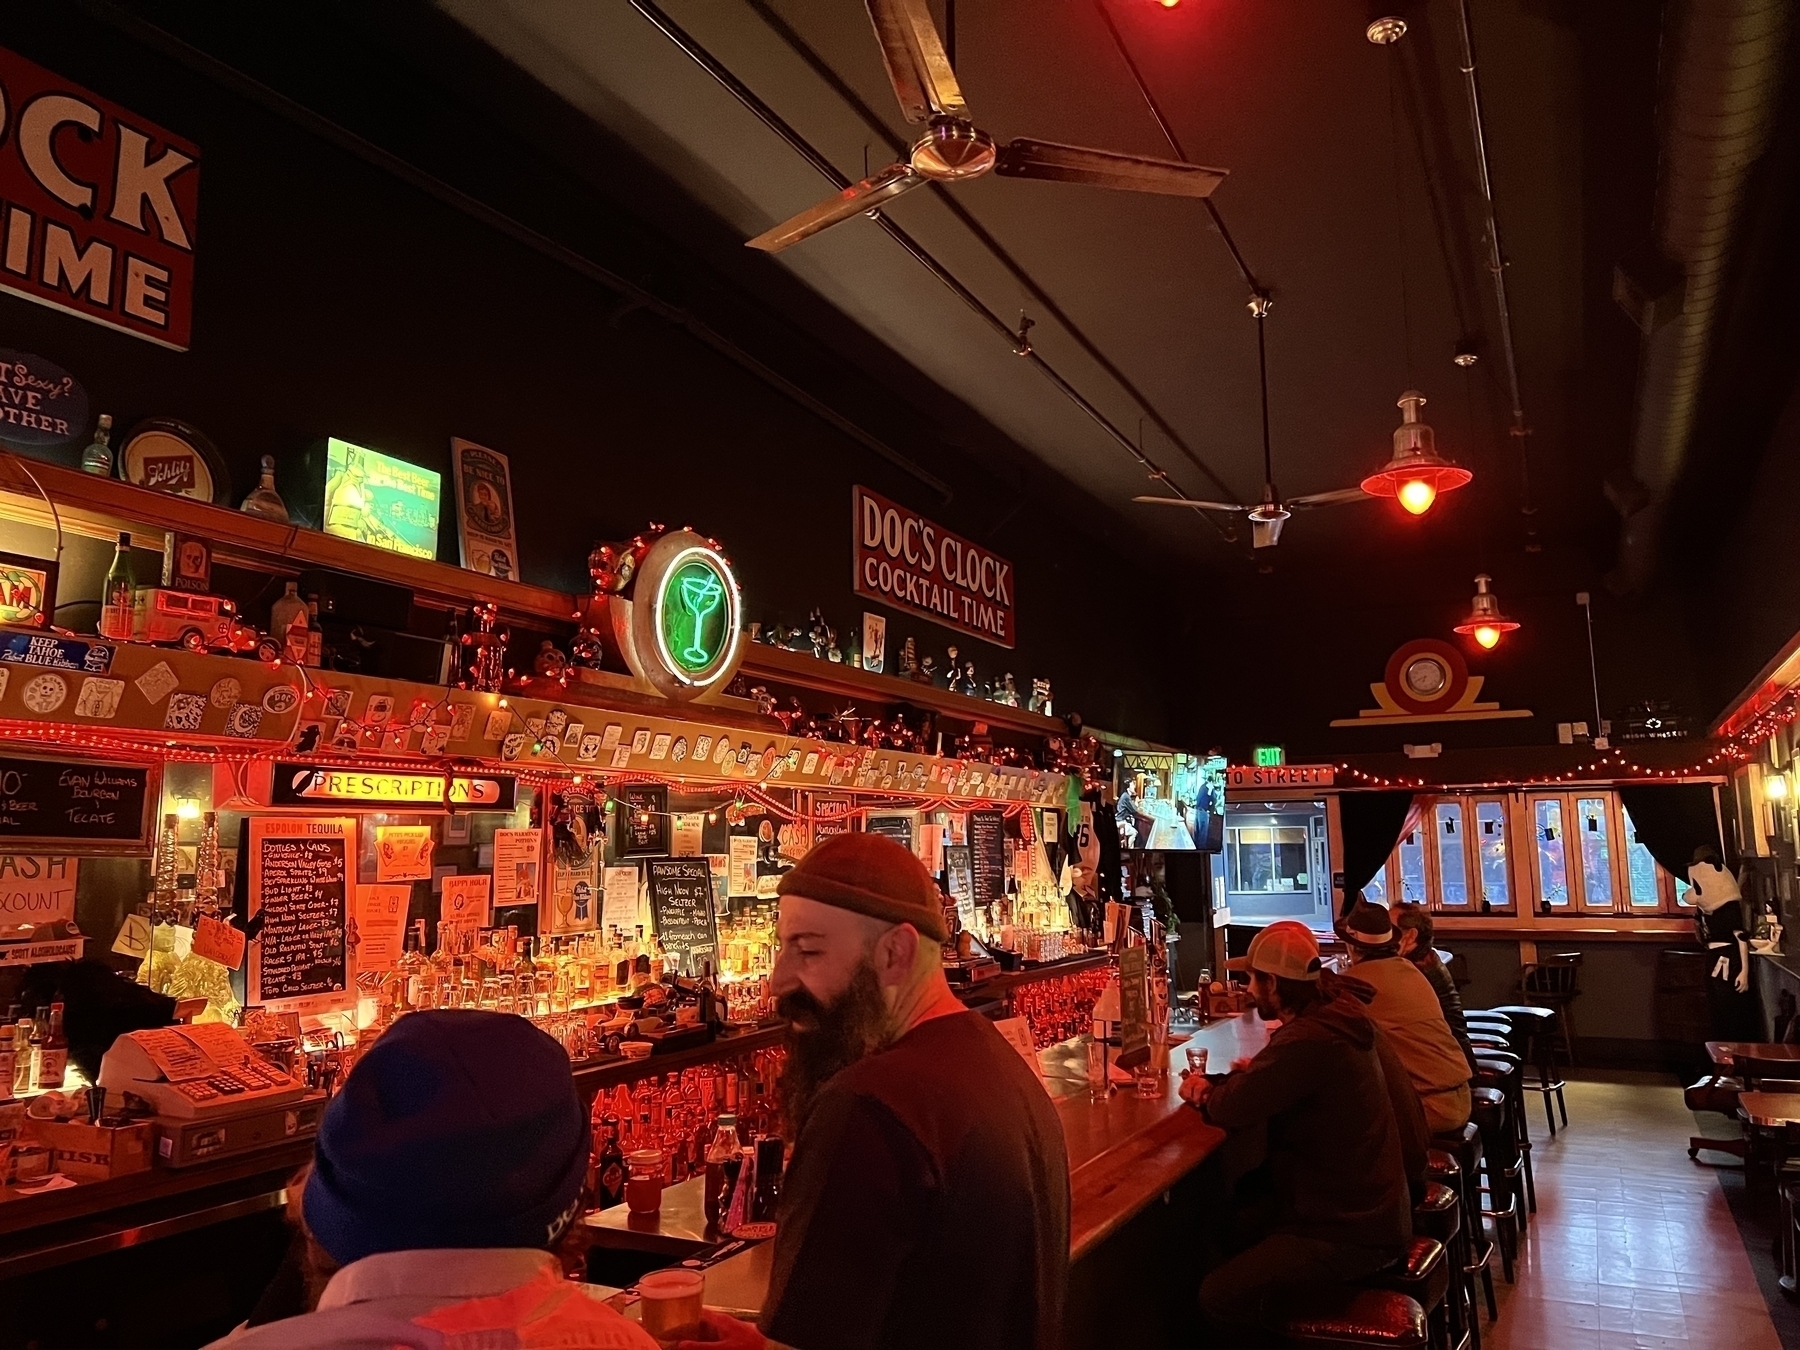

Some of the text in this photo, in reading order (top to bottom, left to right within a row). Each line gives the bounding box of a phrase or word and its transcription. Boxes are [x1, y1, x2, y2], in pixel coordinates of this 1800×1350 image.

[0, 82, 194, 250] CK
[13, 360, 73, 399] Sexy?
[376, 461, 430, 487] The Best Beer
[475, 466, 495, 482] NICE
[416, 485, 435, 501] Time
[375, 533, 393, 550] San
[393, 539, 433, 559] Francisco
[863, 495, 1010, 607] DOC'S CLOCK
[175, 577, 209, 592] POISON
[864, 557, 1006, 637] COCKTAIL TIME
[30, 636, 58, 648] KEEP
[25, 653, 52, 666] BLUE
[29, 645, 64, 658] TAHOE
[1258, 748, 1281, 766] EXIT
[1254, 769, 1320, 785] STREET
[65, 807, 116, 824] TECATE
[306, 823, 343, 834] TEQUILA
[781, 826, 807, 846] CASH
